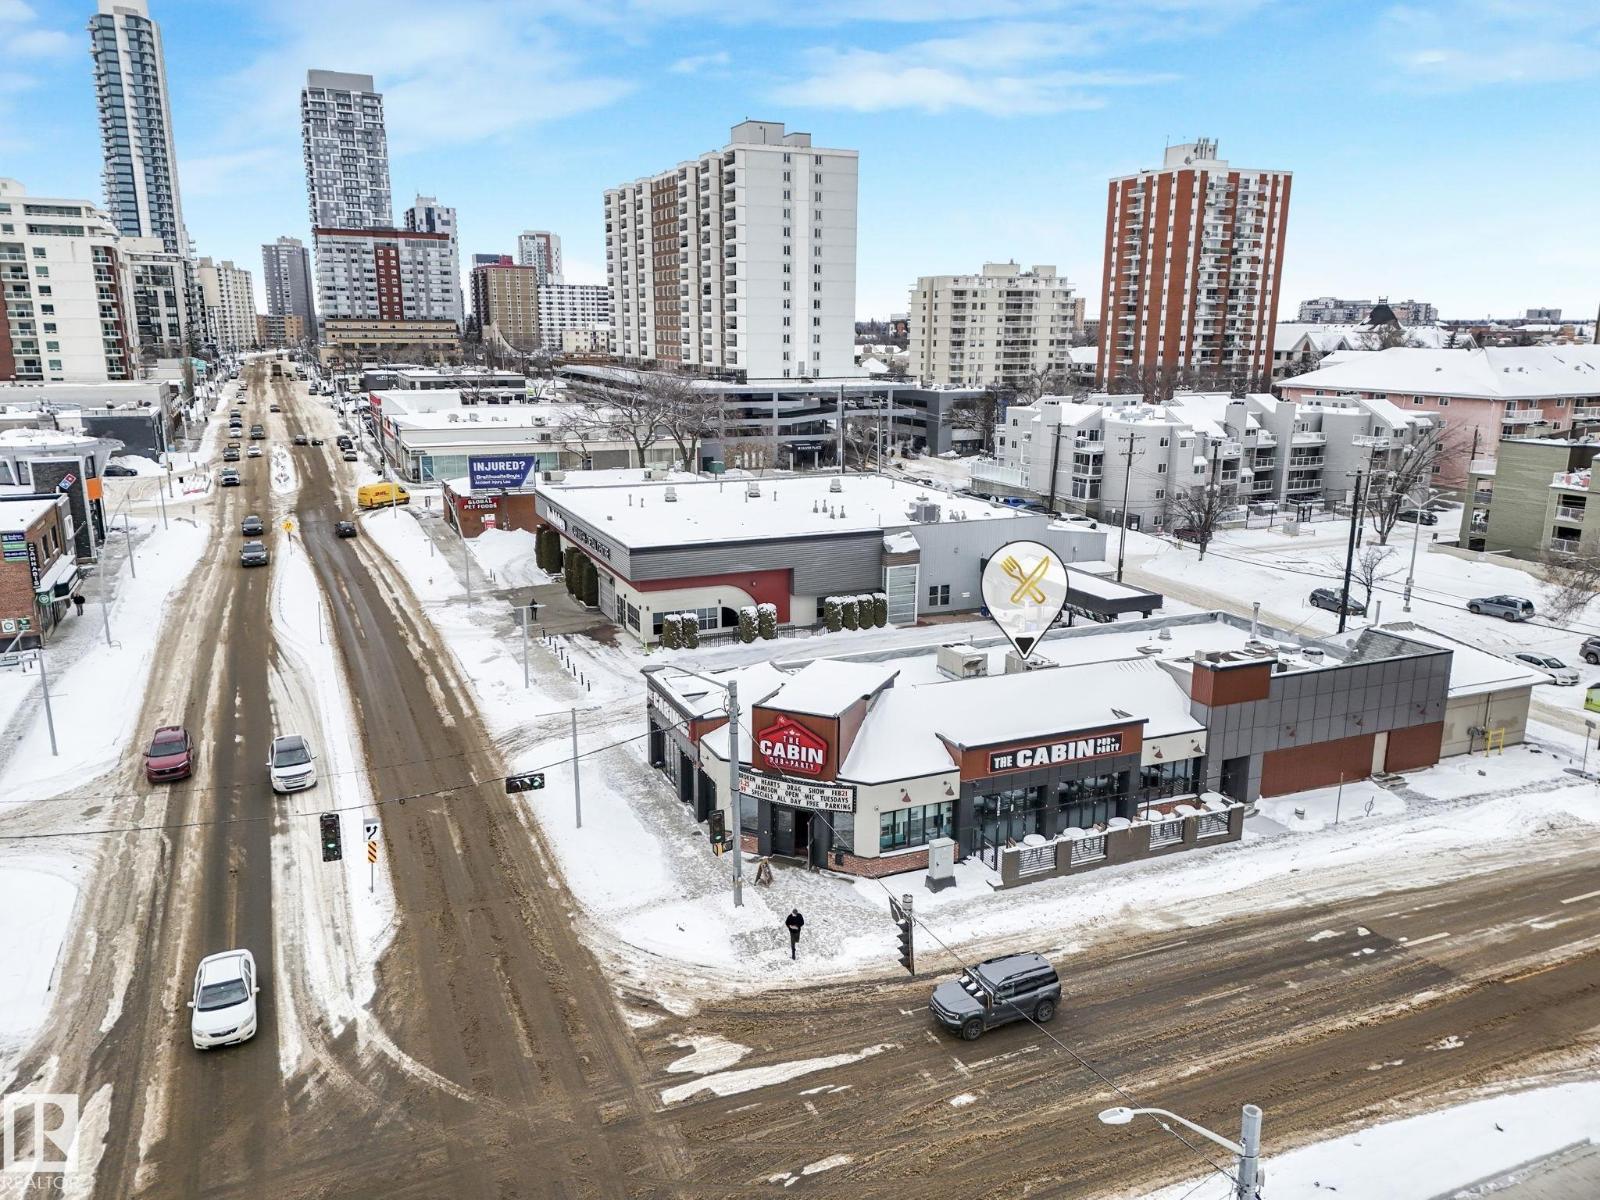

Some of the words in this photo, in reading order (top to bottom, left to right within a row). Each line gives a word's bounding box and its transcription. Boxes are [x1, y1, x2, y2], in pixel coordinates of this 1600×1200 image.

[473, 461, 526, 472] INJURED?
[28, 546, 40, 586] CANNABIS
[783, 736, 800, 744] THE
[1096, 743, 1119, 753] PARTY
[760, 740, 822, 764] CABIN
[994, 755, 1013, 769] THE
[1016, 739, 1094, 767] CABIN
[761, 778, 780, 788] HEARTS
[786, 783, 801, 792] DRAG
[808, 787, 824, 795] SHOW
[751, 789, 774, 799] SPECIALS
[790, 797, 801, 805] DAY
[825, 802, 851, 810] PARKING
[785, 790, 799, 798] OPEN
[820, 795, 848, 803] TUESDAYS
